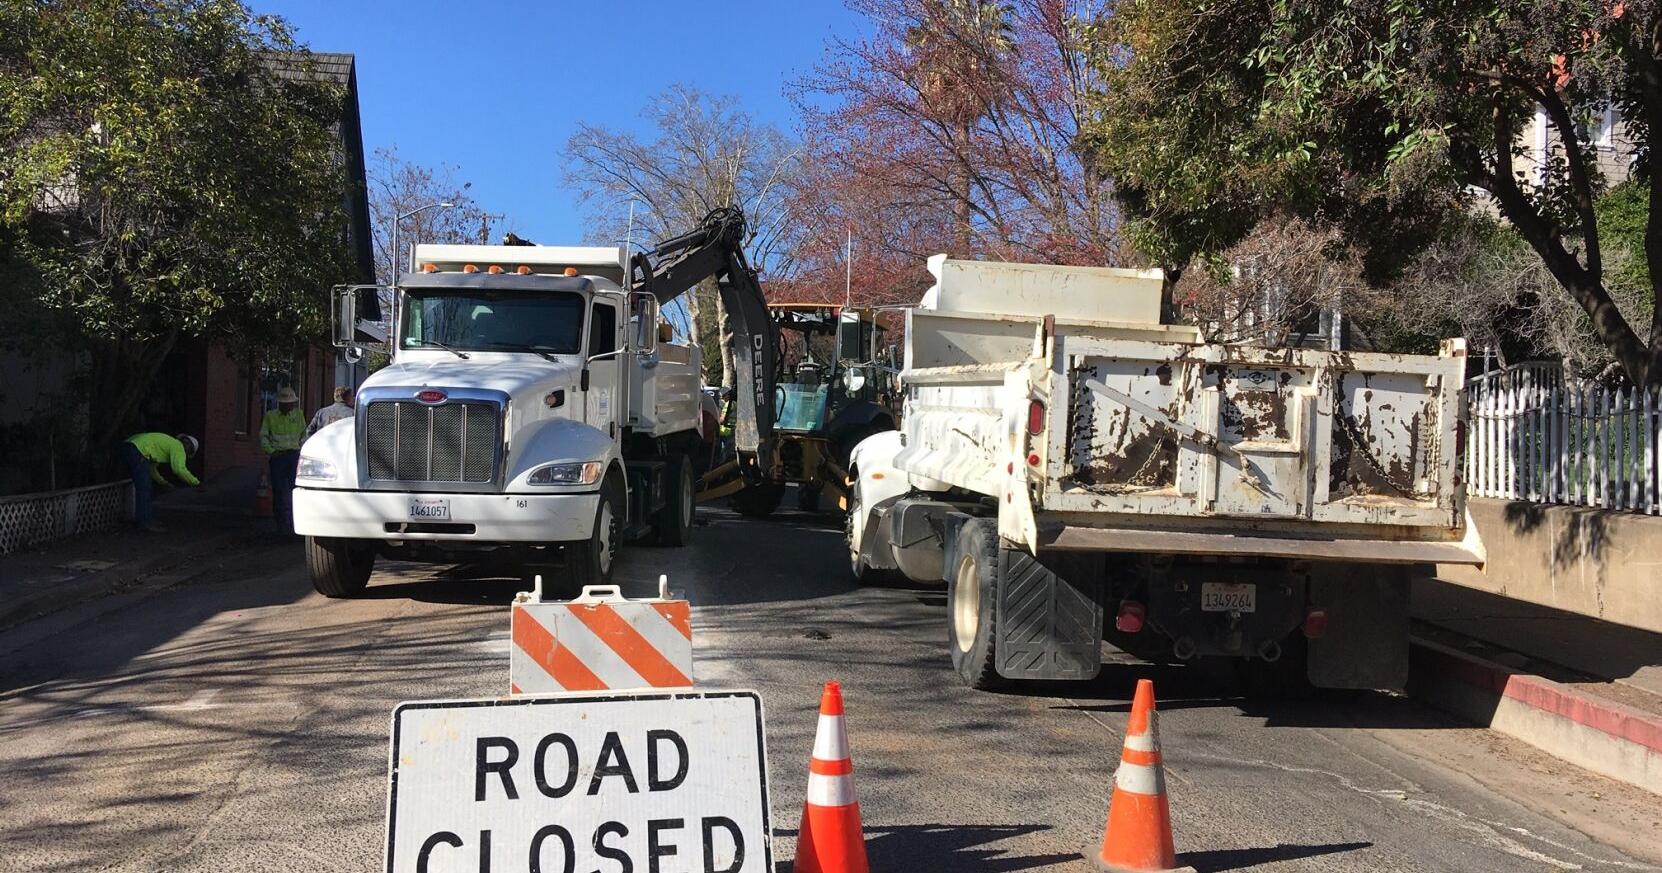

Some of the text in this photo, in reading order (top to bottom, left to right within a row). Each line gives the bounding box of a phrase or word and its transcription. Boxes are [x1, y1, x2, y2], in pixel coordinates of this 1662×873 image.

[754, 334, 765, 407] DEERE
[410, 506, 447, 517] 1461057
[516, 500, 527, 508] 161
[1205, 593, 1252, 608] 1349264
[475, 729, 690, 801] ROAD
[416, 816, 746, 873] CLOSED
